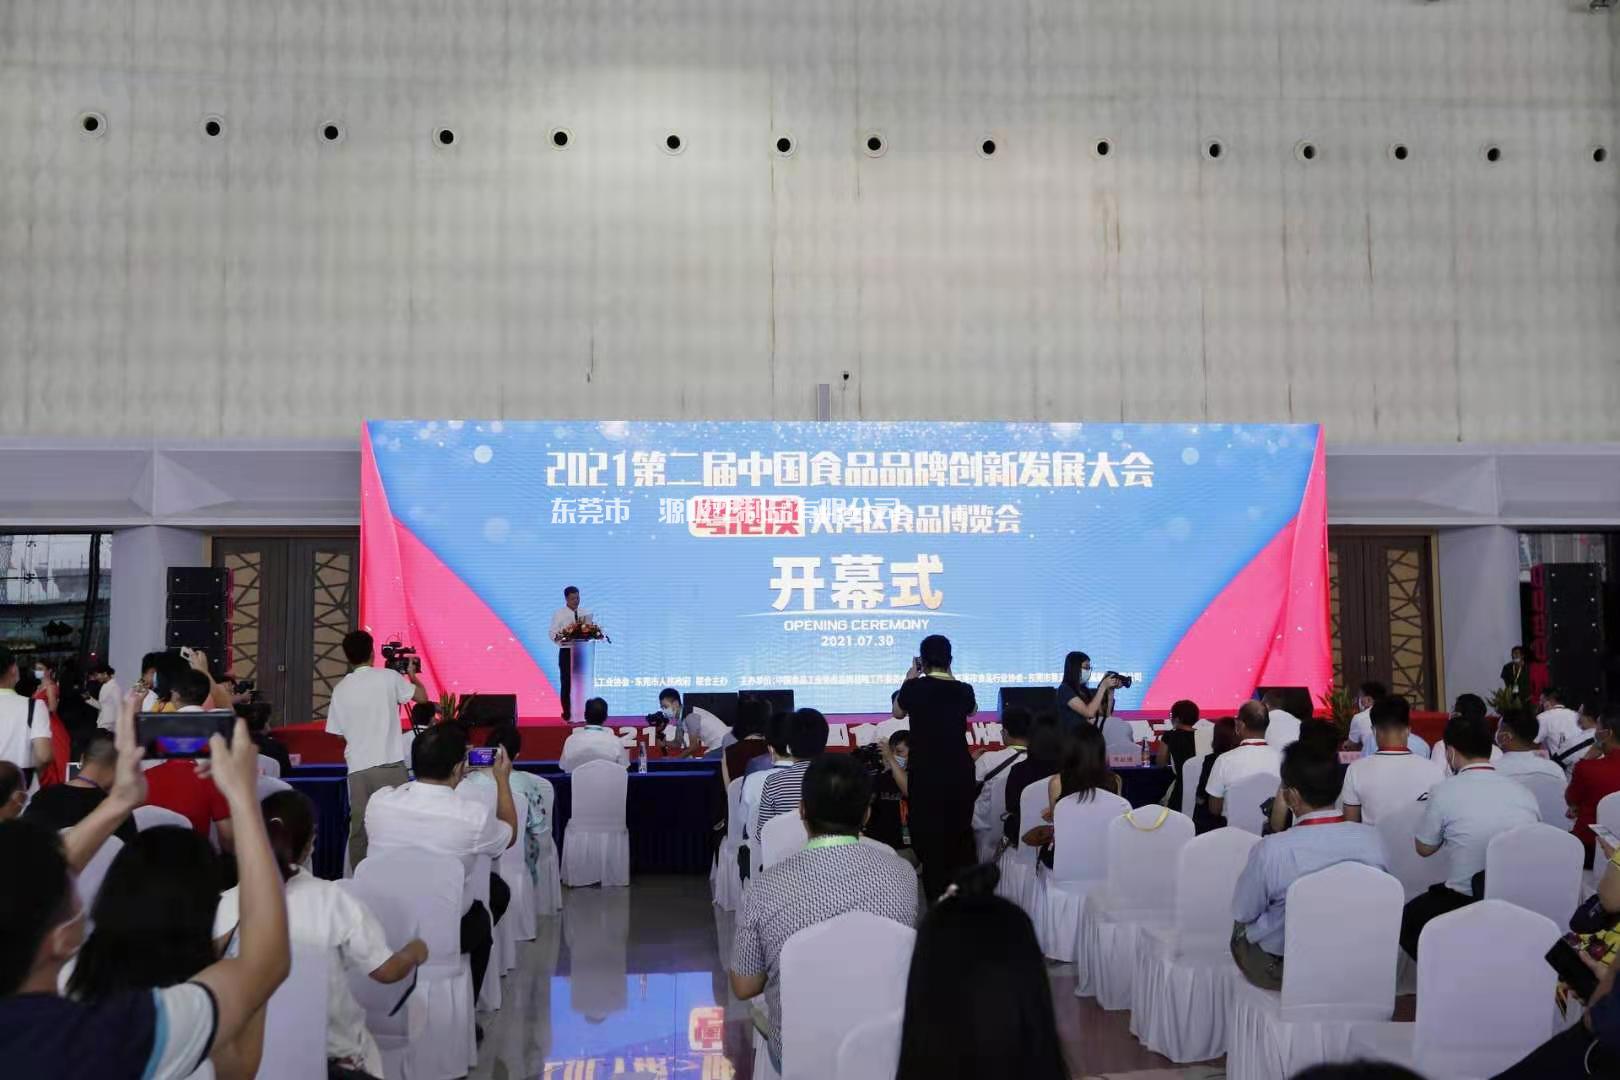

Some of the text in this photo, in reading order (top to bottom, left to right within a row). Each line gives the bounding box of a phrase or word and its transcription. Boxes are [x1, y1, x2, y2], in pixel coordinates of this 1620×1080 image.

[546, 451, 1154, 488] 2021第二届中国食品品牌创新发展大会
[551, 497, 630, 525] 东莞市
[769, 554, 945, 612] 开幕式
[783, 619, 930, 632] OPENING CEREMONY
[821, 634, 894, 647] 2021.07.30
